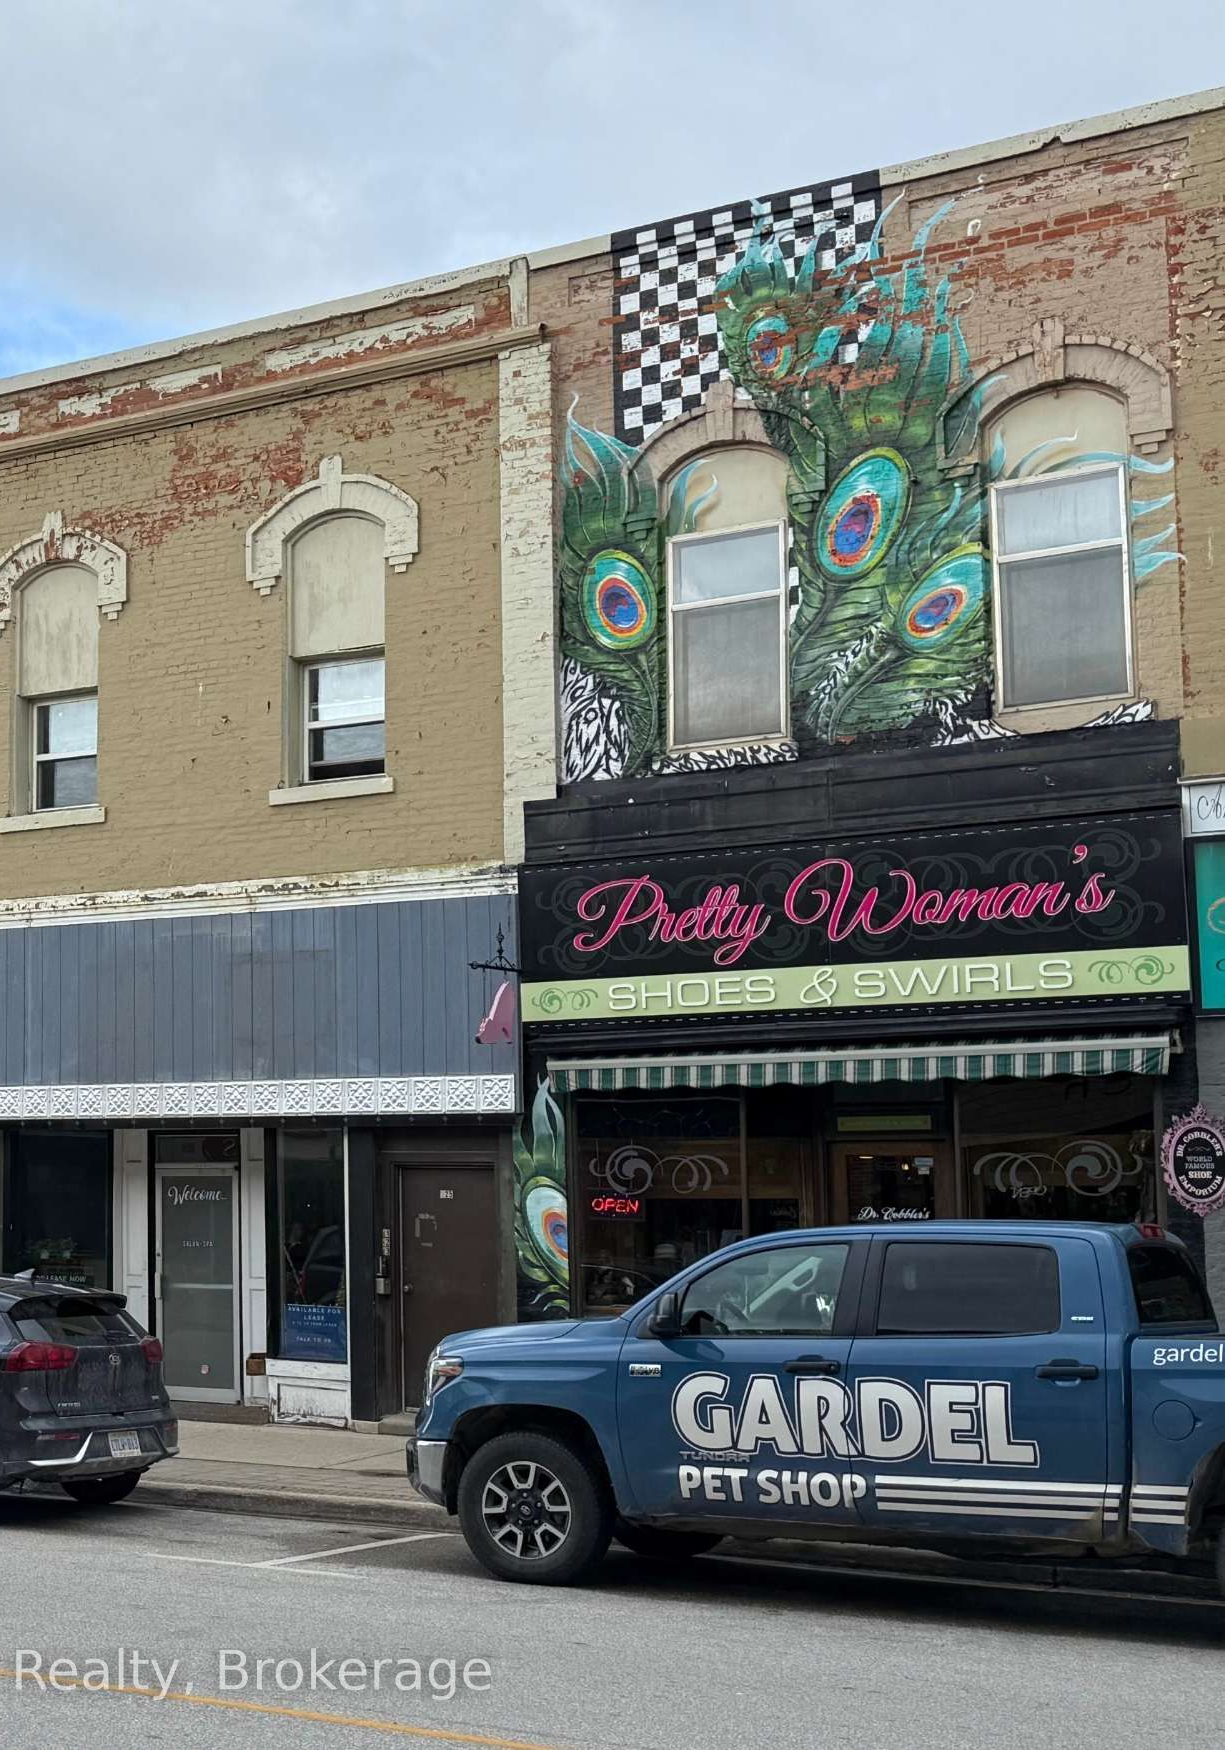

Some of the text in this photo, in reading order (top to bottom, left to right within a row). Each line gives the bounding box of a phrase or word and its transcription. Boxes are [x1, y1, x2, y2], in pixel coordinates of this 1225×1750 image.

[573, 845, 1115, 966] Pretty Woman's
[608, 959, 1075, 1012] SHOES & SWIRLS
[1178, 1175, 1223, 1196] EMPORIUM
[1188, 1171, 1213, 1179] SHOE
[167, 1184, 226, 1205] Welcome
[591, 1198, 639, 1213] OPEN
[858, 1206, 931, 1222] Dr. Cobbler's
[287, 1306, 325, 1314] AVAILABLE
[672, 1370, 1040, 1469] GARDEL
[679, 1450, 752, 1463] TUNDRA
[677, 1465, 867, 1510] PET SHOP
